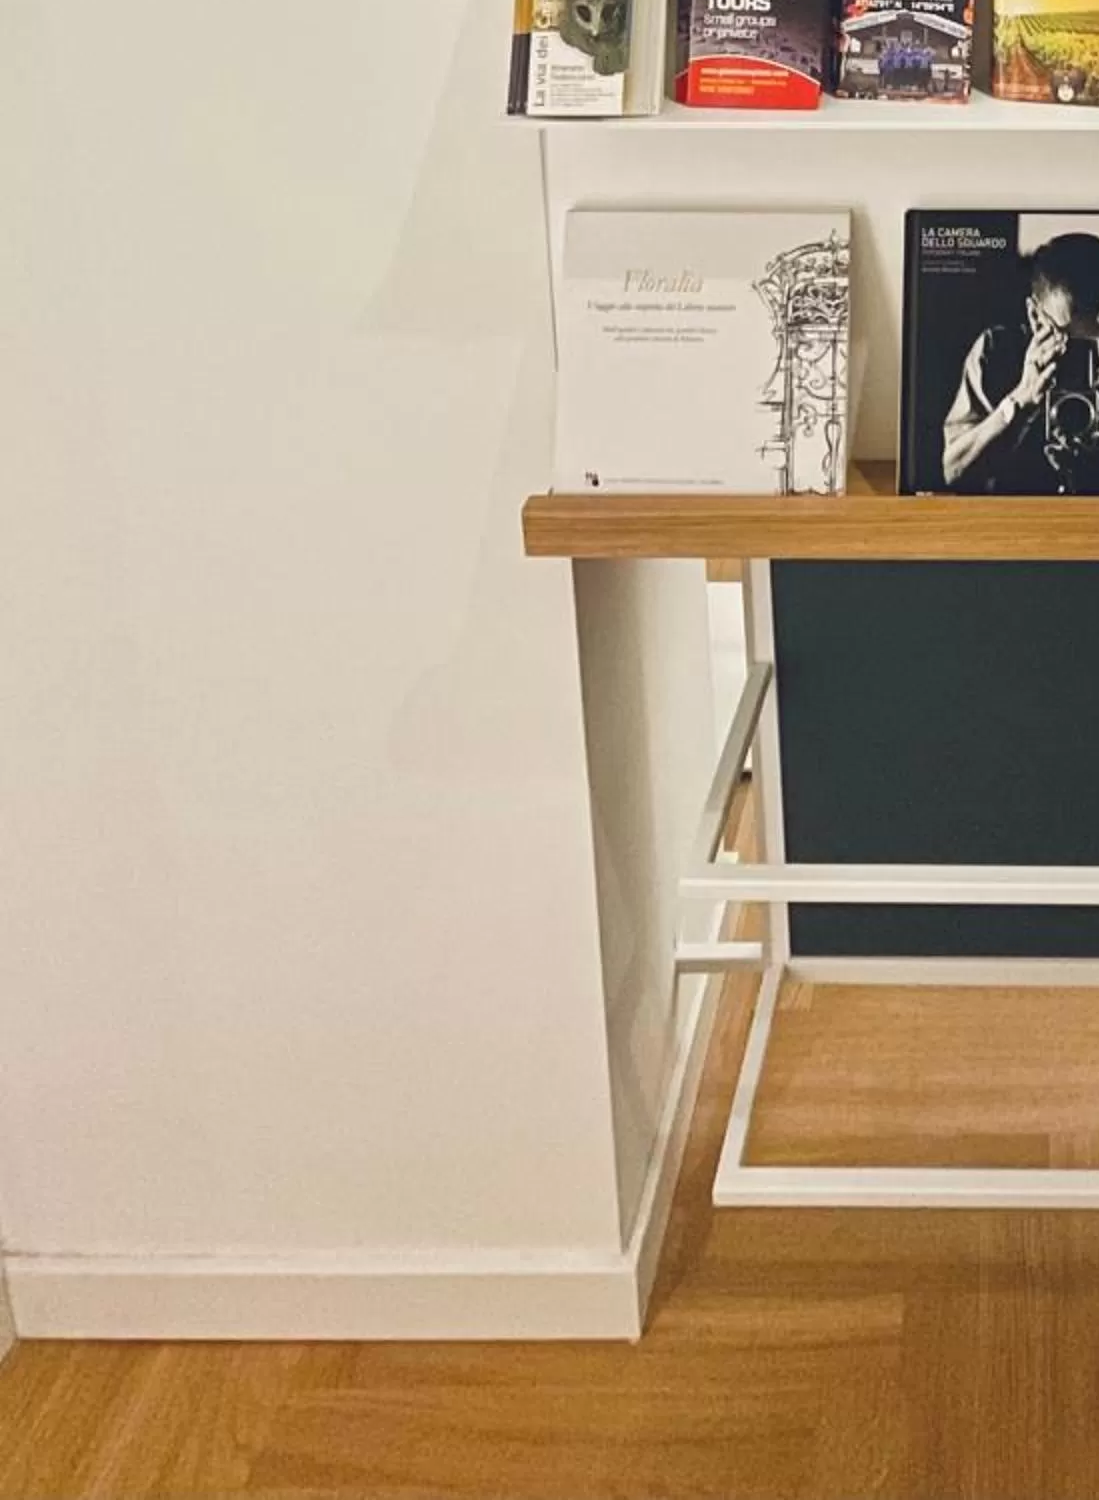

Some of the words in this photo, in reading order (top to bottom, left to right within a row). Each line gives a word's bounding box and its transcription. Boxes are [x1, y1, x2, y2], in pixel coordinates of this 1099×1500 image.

[921, 227, 935, 237] LA
[937, 227, 980, 237] CAMERA
[921, 238, 954, 248] DELLO
